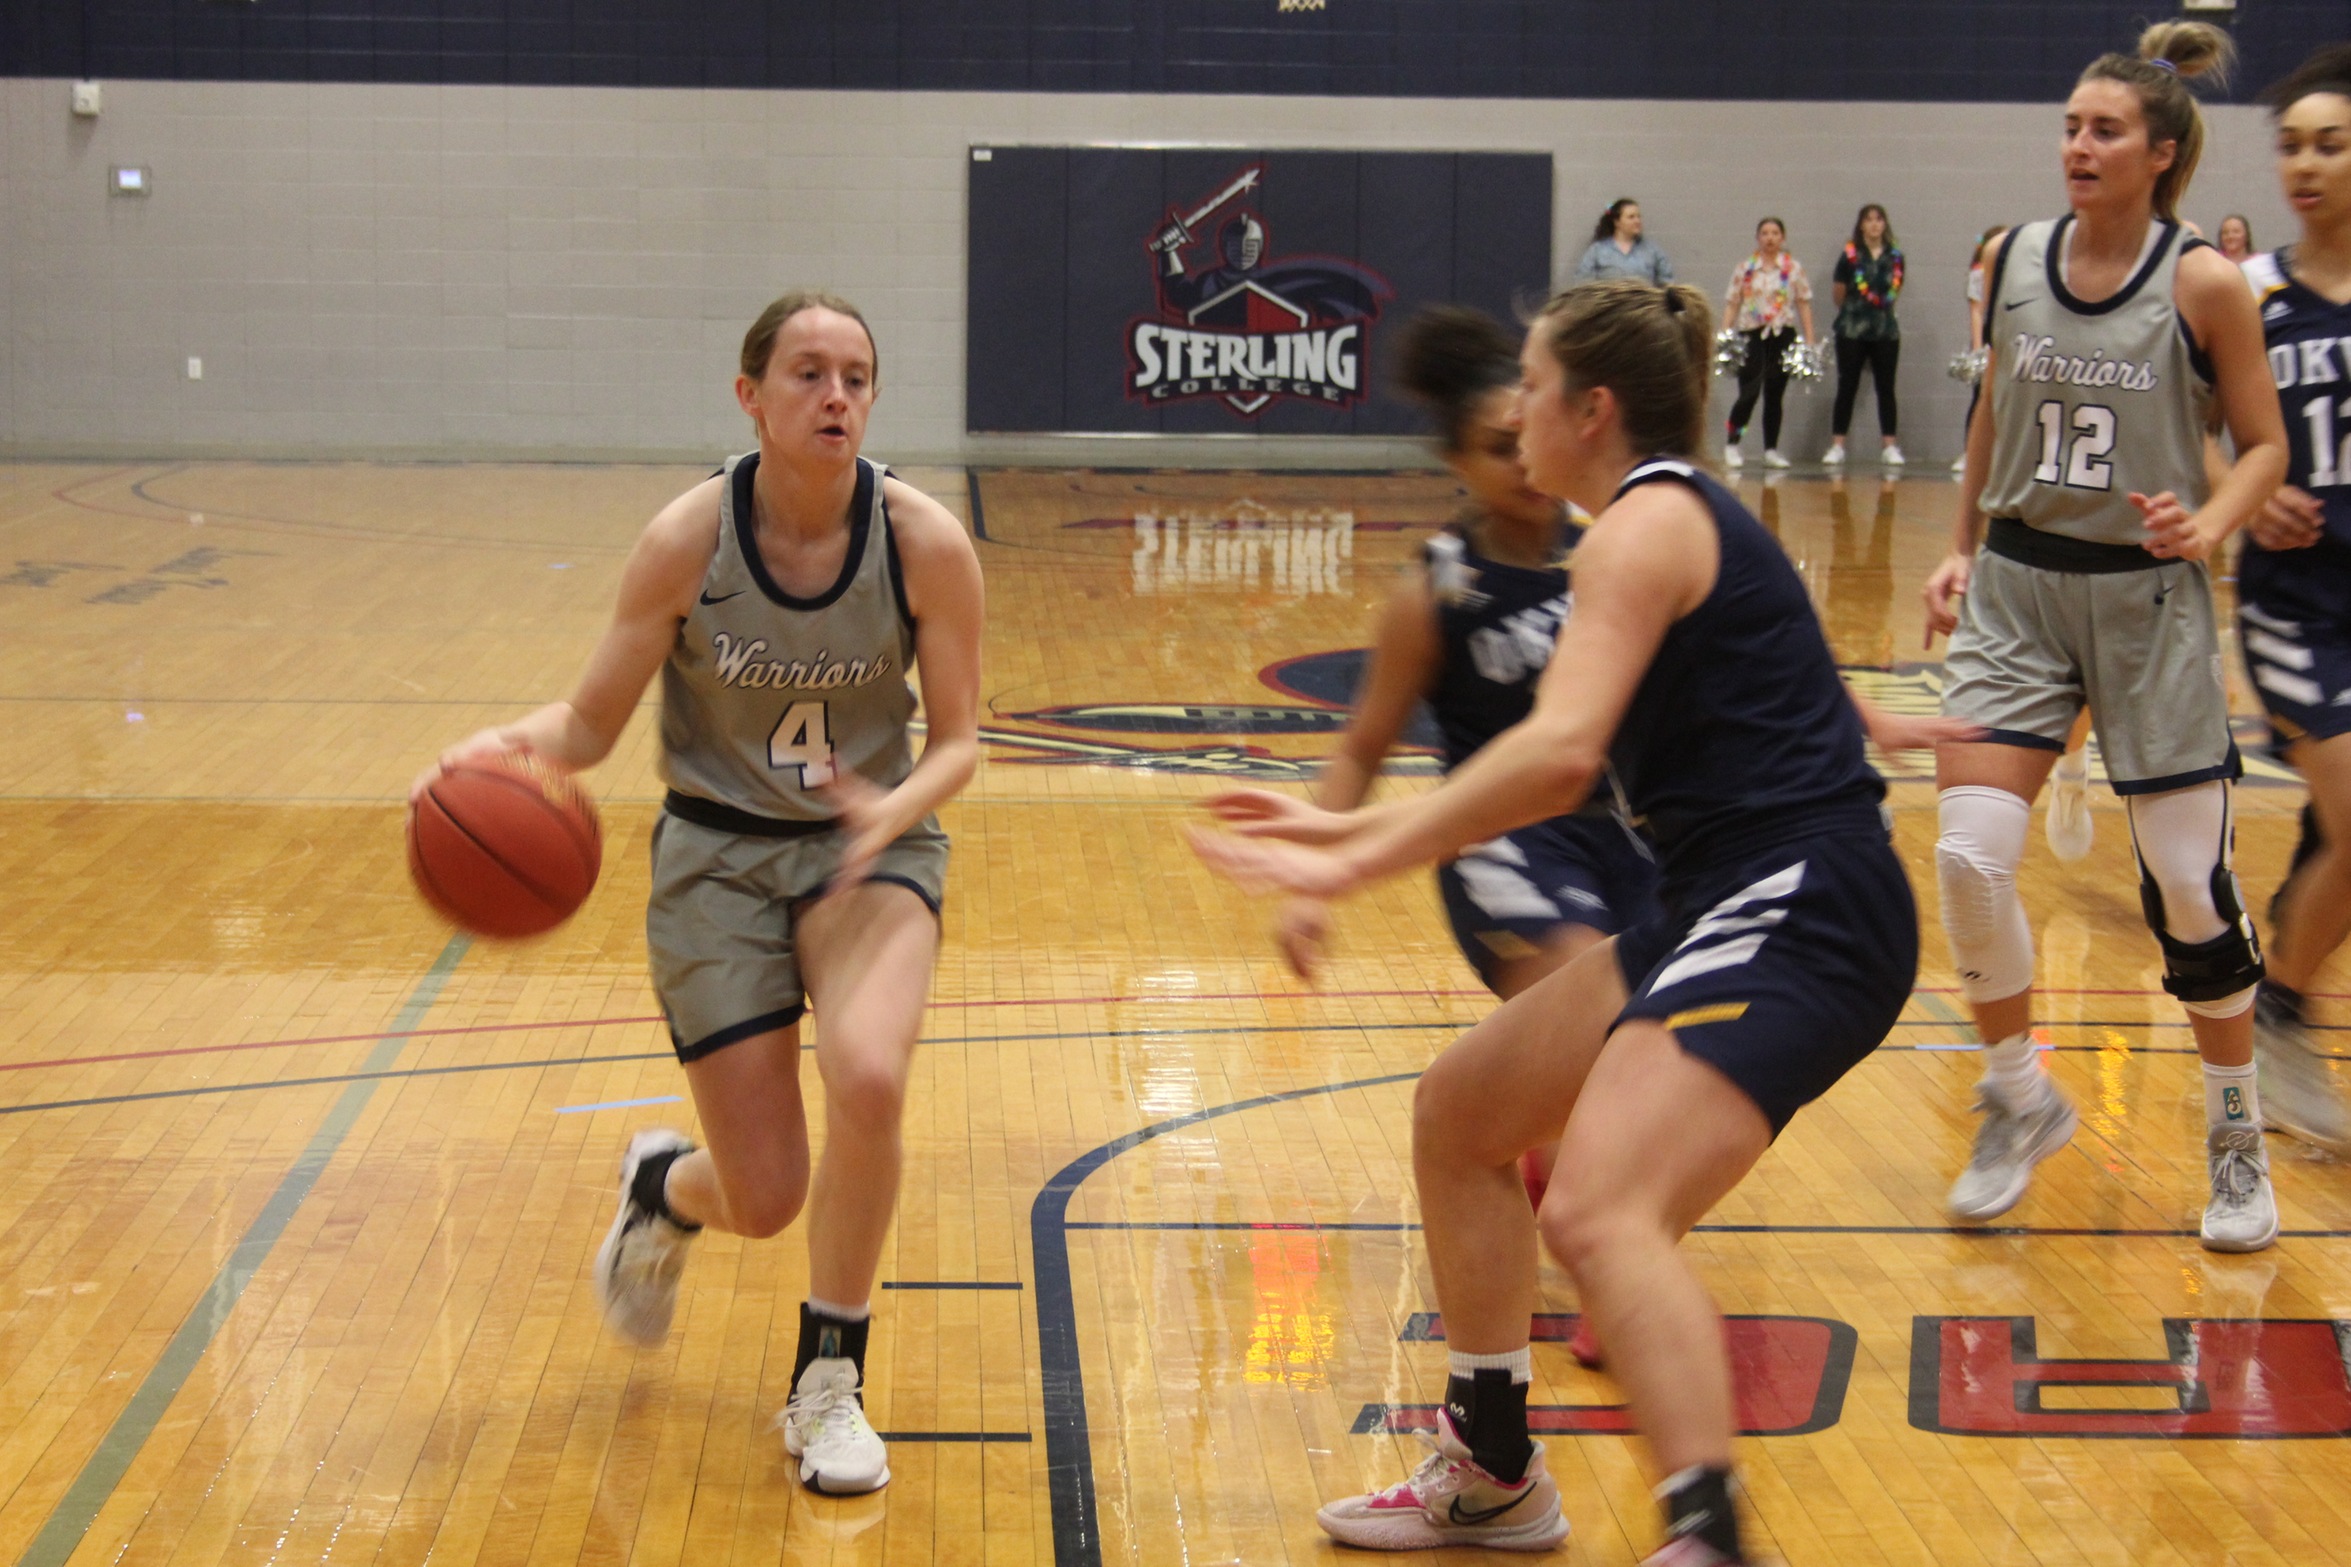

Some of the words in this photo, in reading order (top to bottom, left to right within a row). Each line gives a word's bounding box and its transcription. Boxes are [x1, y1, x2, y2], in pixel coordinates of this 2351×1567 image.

[1135, 322, 1358, 391] STERLING
[2011, 332, 2158, 391] Warriors
[2267, 336, 2351, 390] OK
[1152, 378, 1339, 401] COLLEGE
[2034, 399, 2118, 491] 12
[713, 631, 892, 691] Warriors
[767, 700, 839, 791] 4
